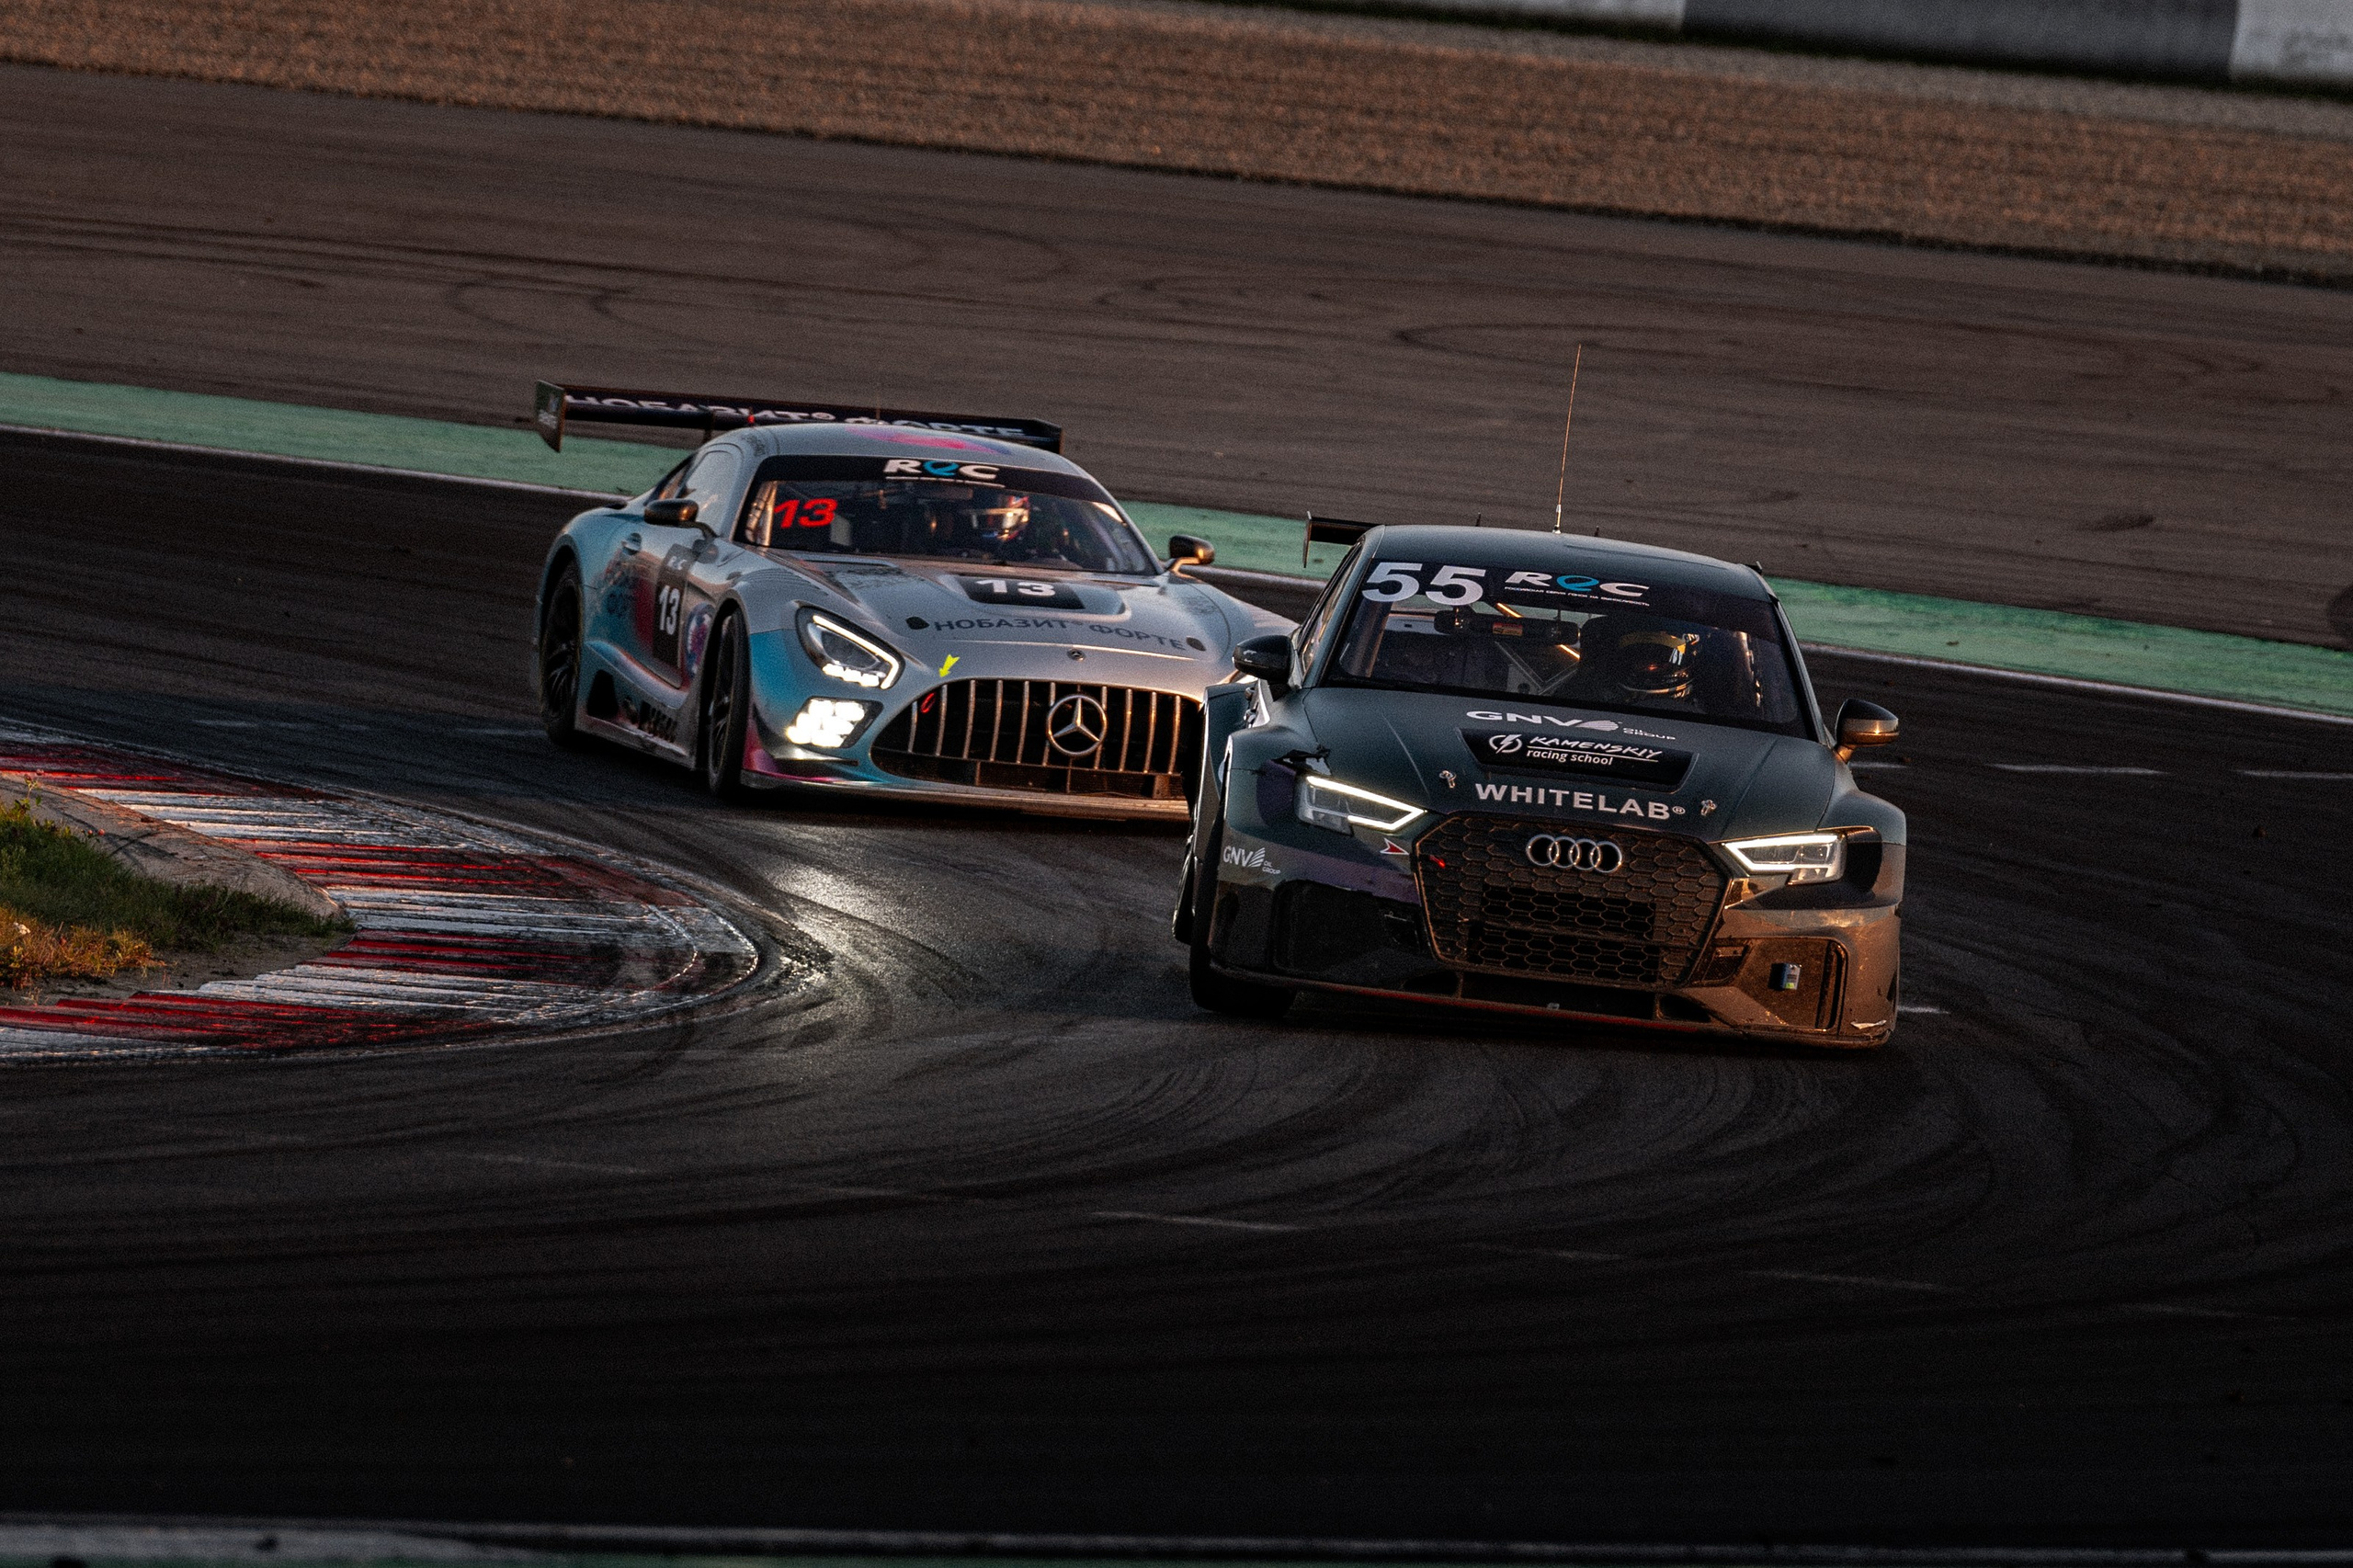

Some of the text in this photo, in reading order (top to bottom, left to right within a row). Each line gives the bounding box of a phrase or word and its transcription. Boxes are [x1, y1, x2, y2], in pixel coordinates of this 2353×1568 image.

[773, 498, 837, 528] 13
[977, 579, 1056, 597] 13
[1361, 562, 1486, 606] 55
[659, 585, 680, 635] 13
[1089, 625, 1186, 651] ФОРТЕ
[1467, 710, 1583, 727] GNV
[1526, 748, 1613, 767] racing school
[1529, 735, 1663, 759] KAMENSKIY
[1223, 846, 1254, 867] GNV
